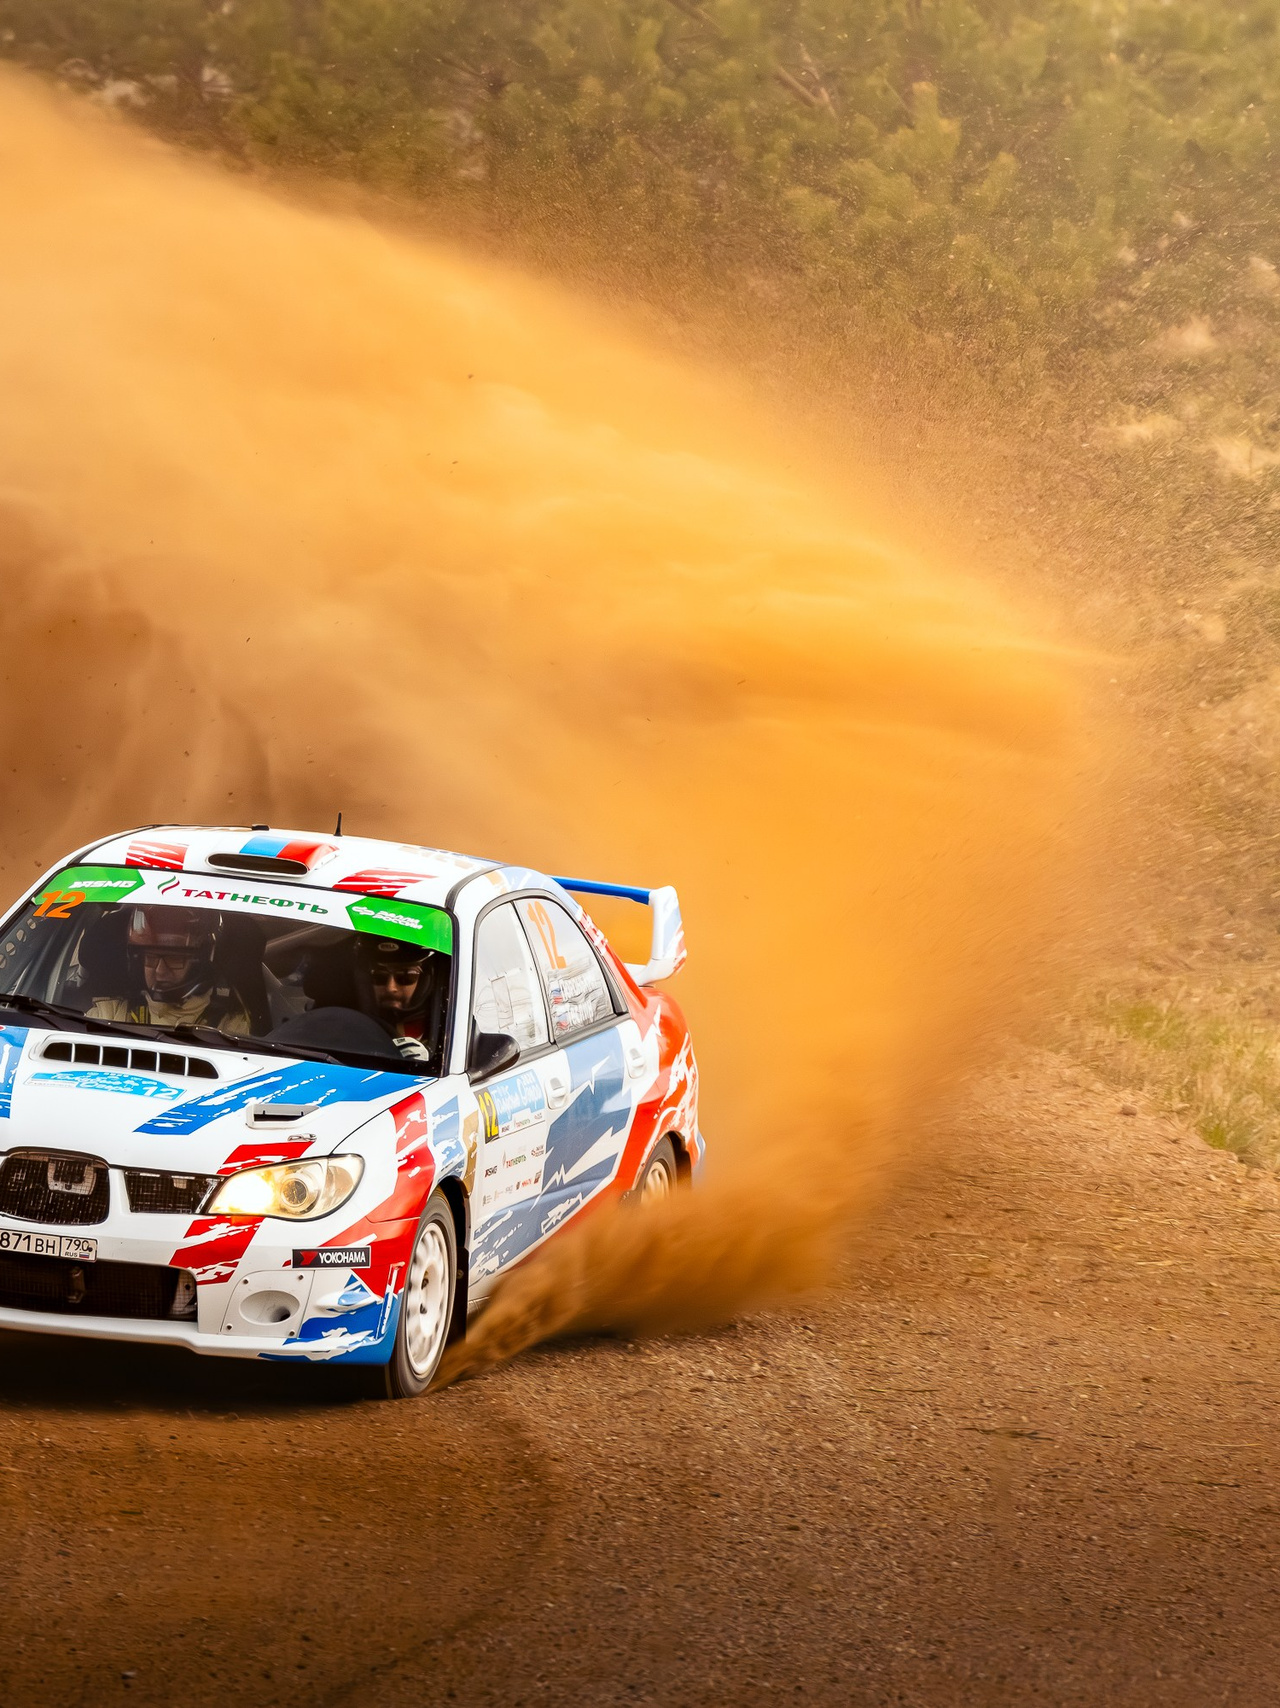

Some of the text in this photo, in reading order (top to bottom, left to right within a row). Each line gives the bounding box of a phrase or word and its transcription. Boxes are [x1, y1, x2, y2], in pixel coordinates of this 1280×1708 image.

[33, 890, 86, 918] 12
[182, 888, 329, 915] ТАТНЕФТЬ
[527, 901, 567, 970] 12
[141, 1086, 180, 1100] 12
[478, 1091, 499, 1138] 12
[65, 1238, 90, 1252] 790
[319, 1251, 366, 1264] YOKOHAMA
